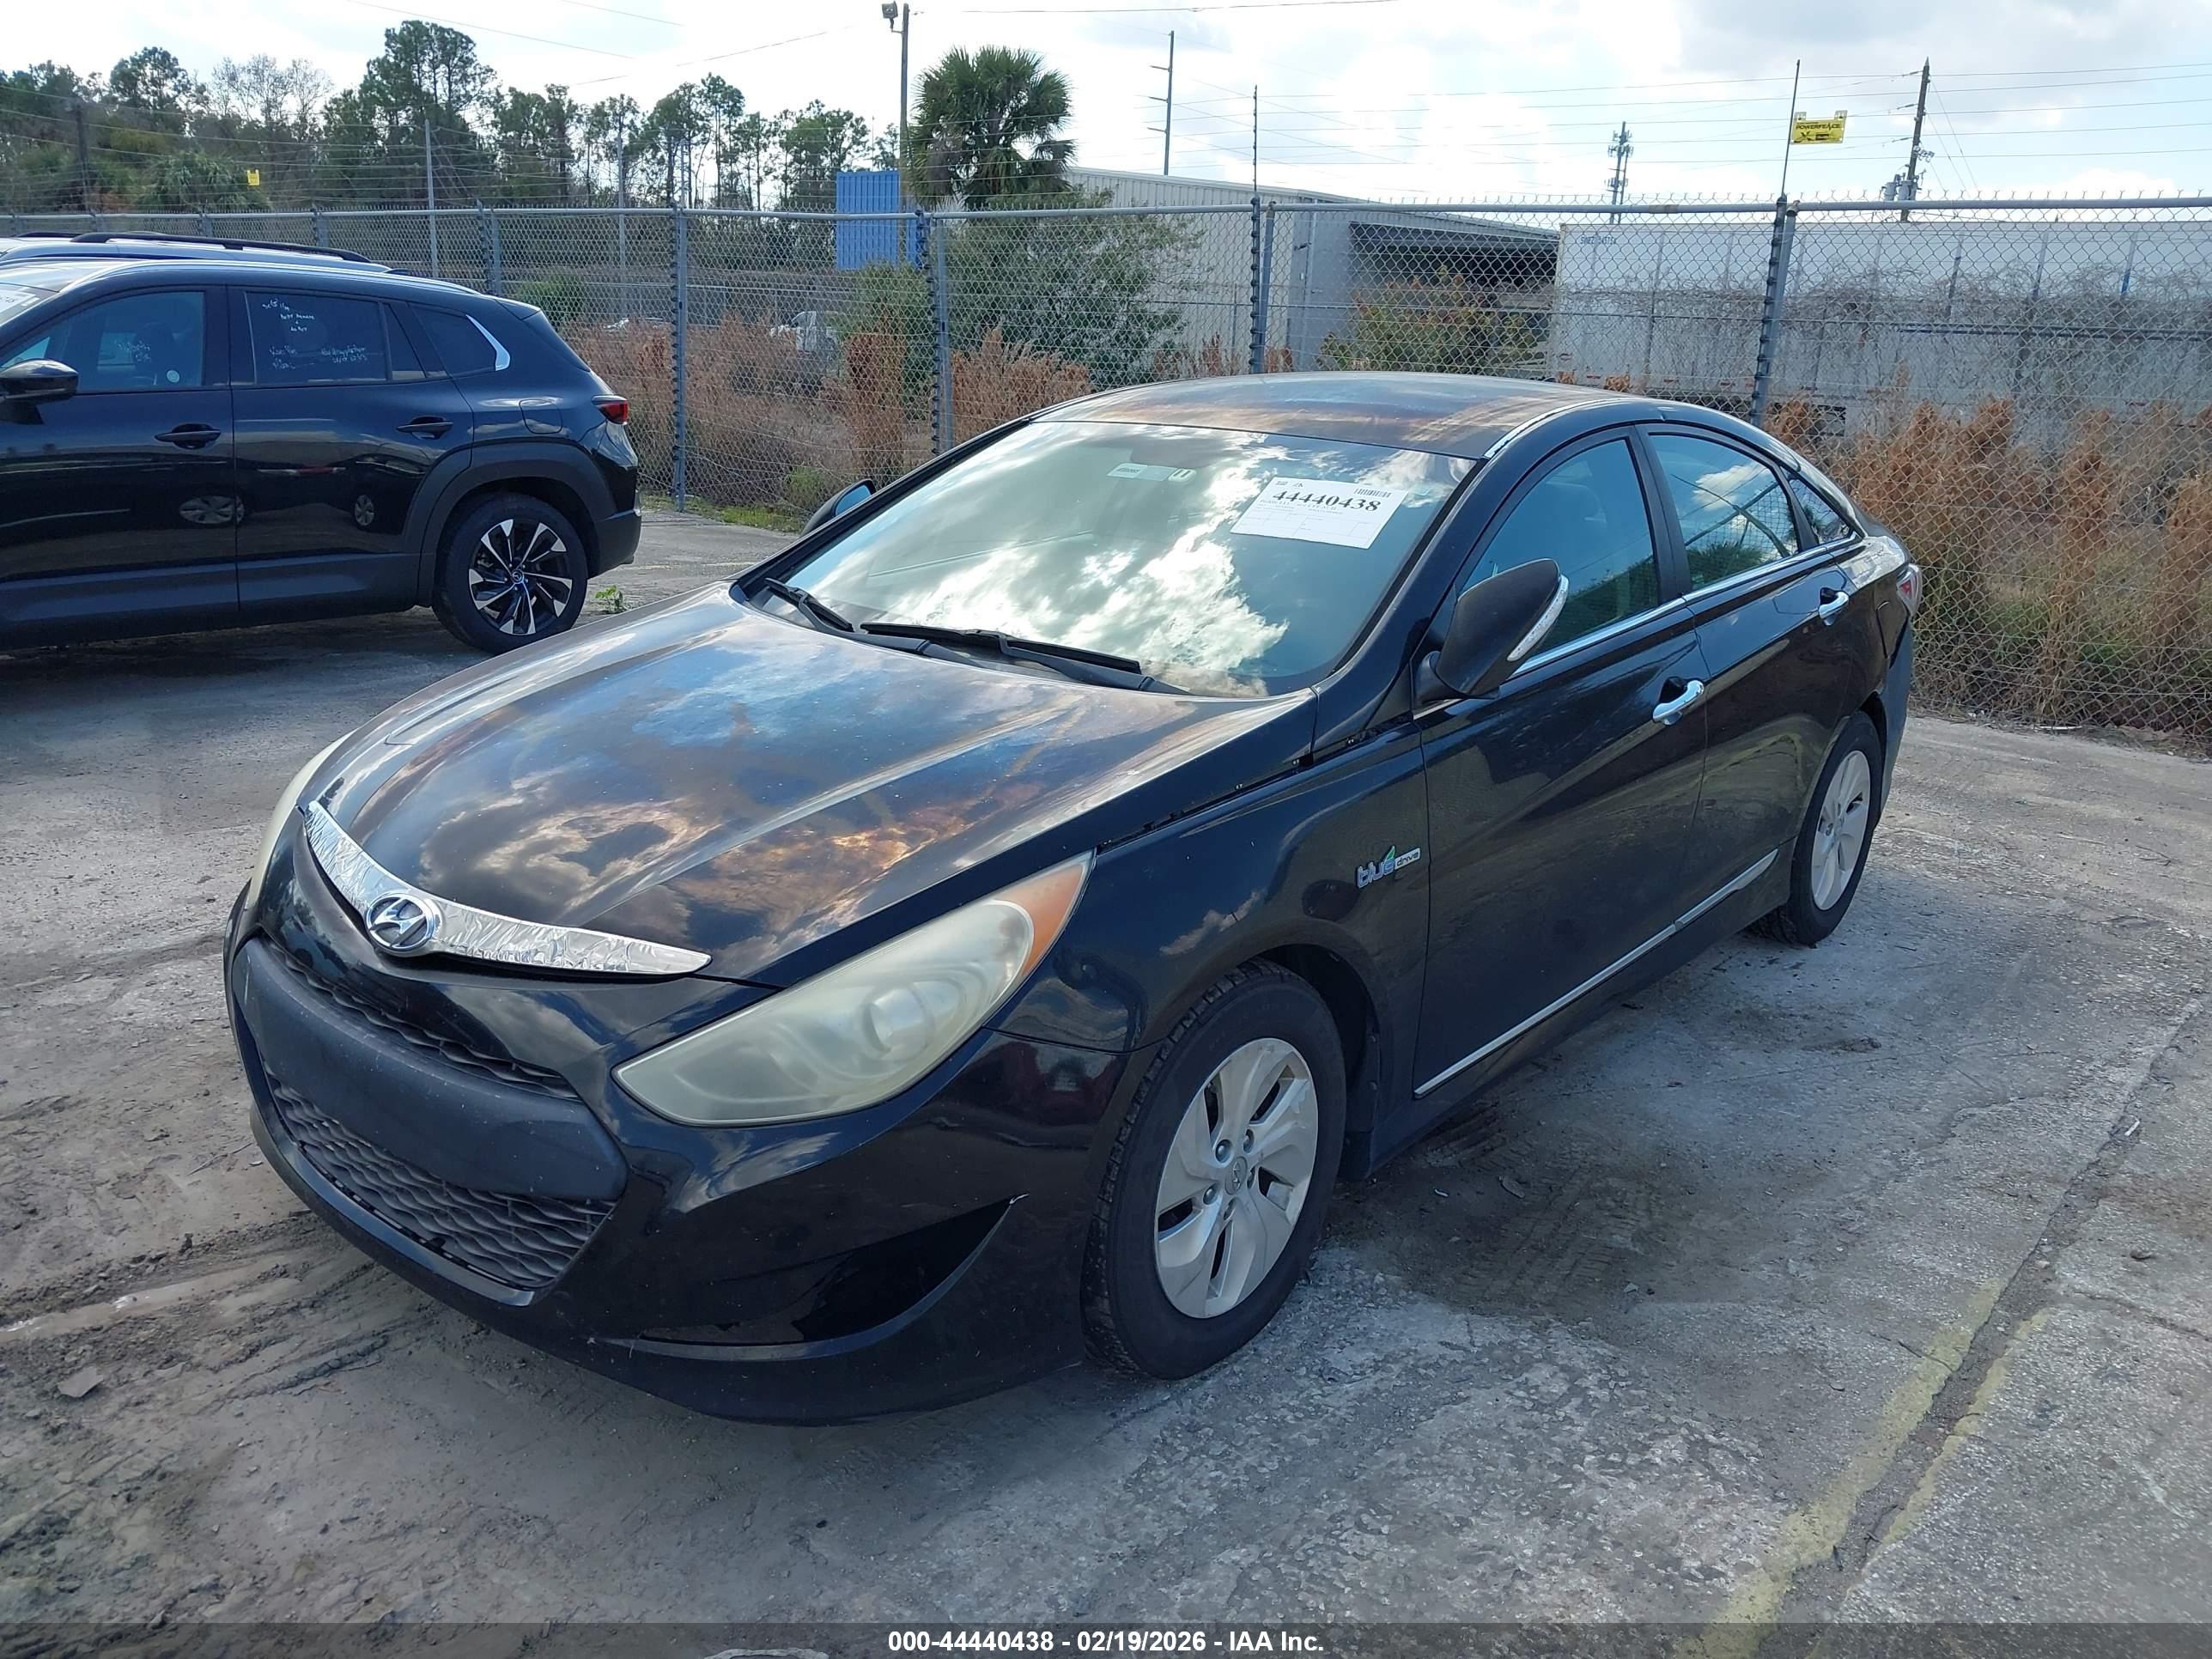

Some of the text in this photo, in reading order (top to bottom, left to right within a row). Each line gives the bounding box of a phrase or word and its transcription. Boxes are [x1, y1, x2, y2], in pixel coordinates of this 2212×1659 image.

[1273, 491, 1382, 511] 44440438
[1358, 850, 1419, 889] blue drive
